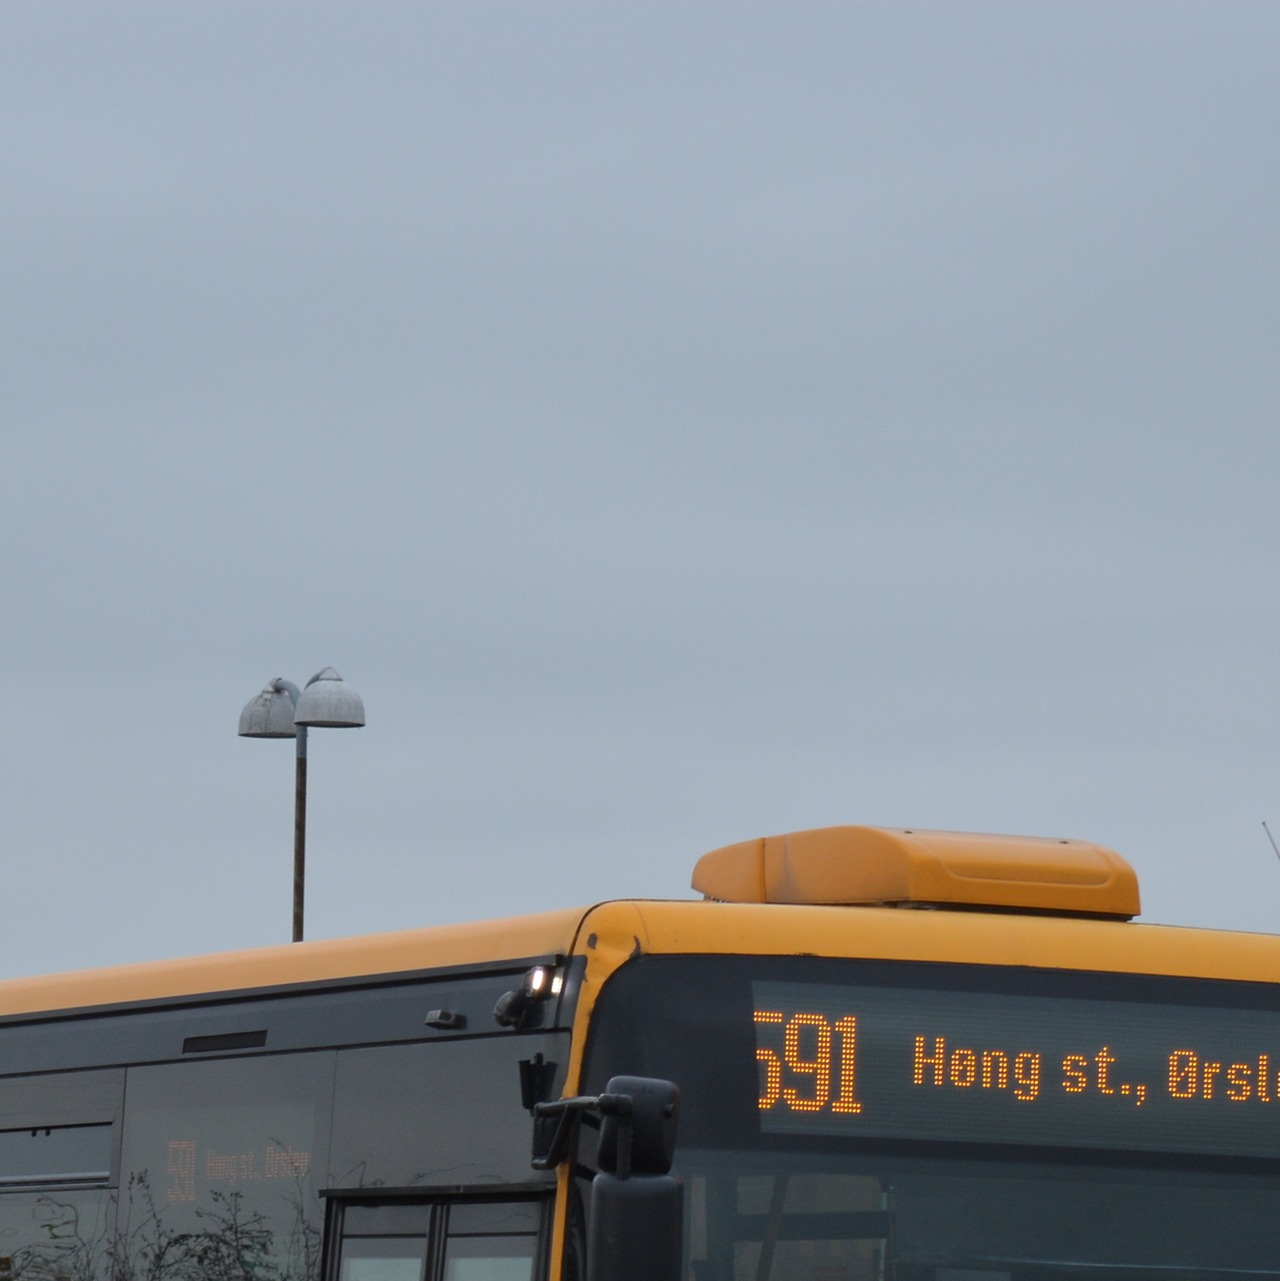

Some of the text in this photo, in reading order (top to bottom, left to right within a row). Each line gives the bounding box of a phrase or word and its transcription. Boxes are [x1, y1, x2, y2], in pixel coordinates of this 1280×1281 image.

[753, 1011, 861, 1113] 591
[913, 1036, 1040, 1100] Høng
[1062, 1046, 1146, 1106] st.,
